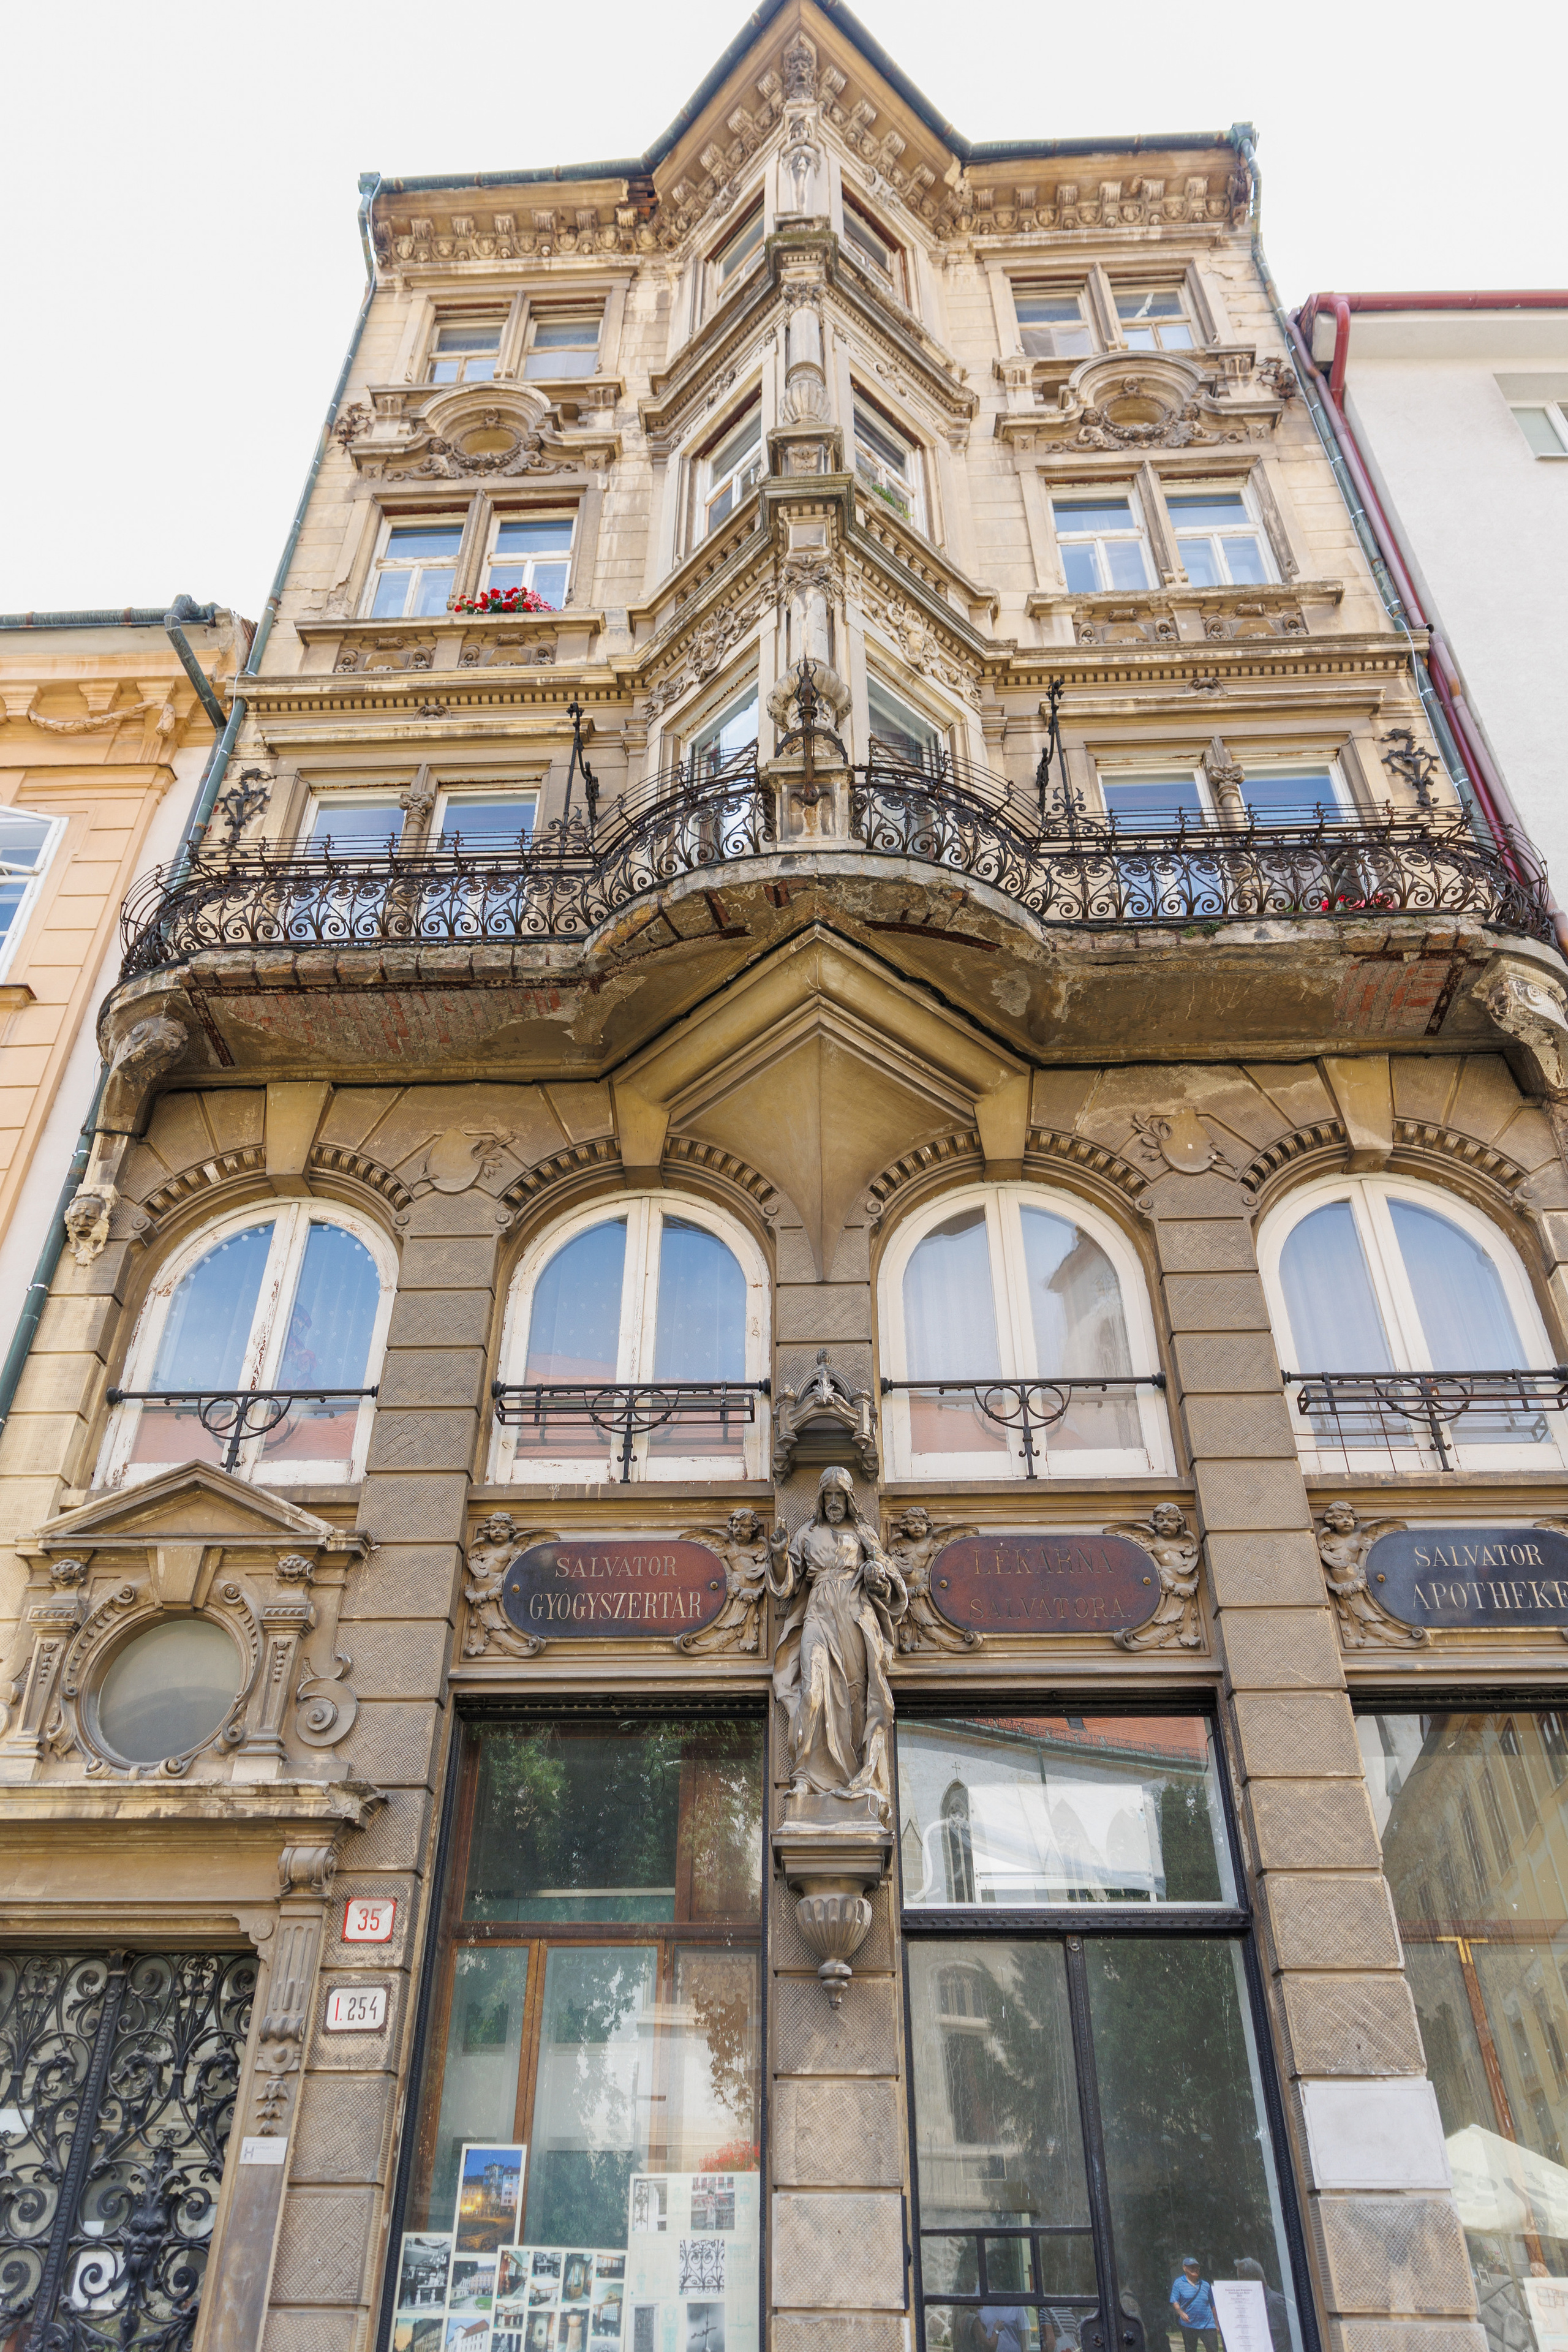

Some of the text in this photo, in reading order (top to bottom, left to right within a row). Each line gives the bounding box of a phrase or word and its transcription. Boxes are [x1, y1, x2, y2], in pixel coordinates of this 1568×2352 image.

[555, 1555, 677, 1578] SALVATOR
[1414, 1544, 1545, 1567] SALVATOR
[529, 1586, 703, 1620] GYÓGYSZERTÁR
[1412, 1580, 1568, 1609] APOTHEKE
[357, 1907, 382, 1932] 35
[347, 1996, 378, 2021] 254
